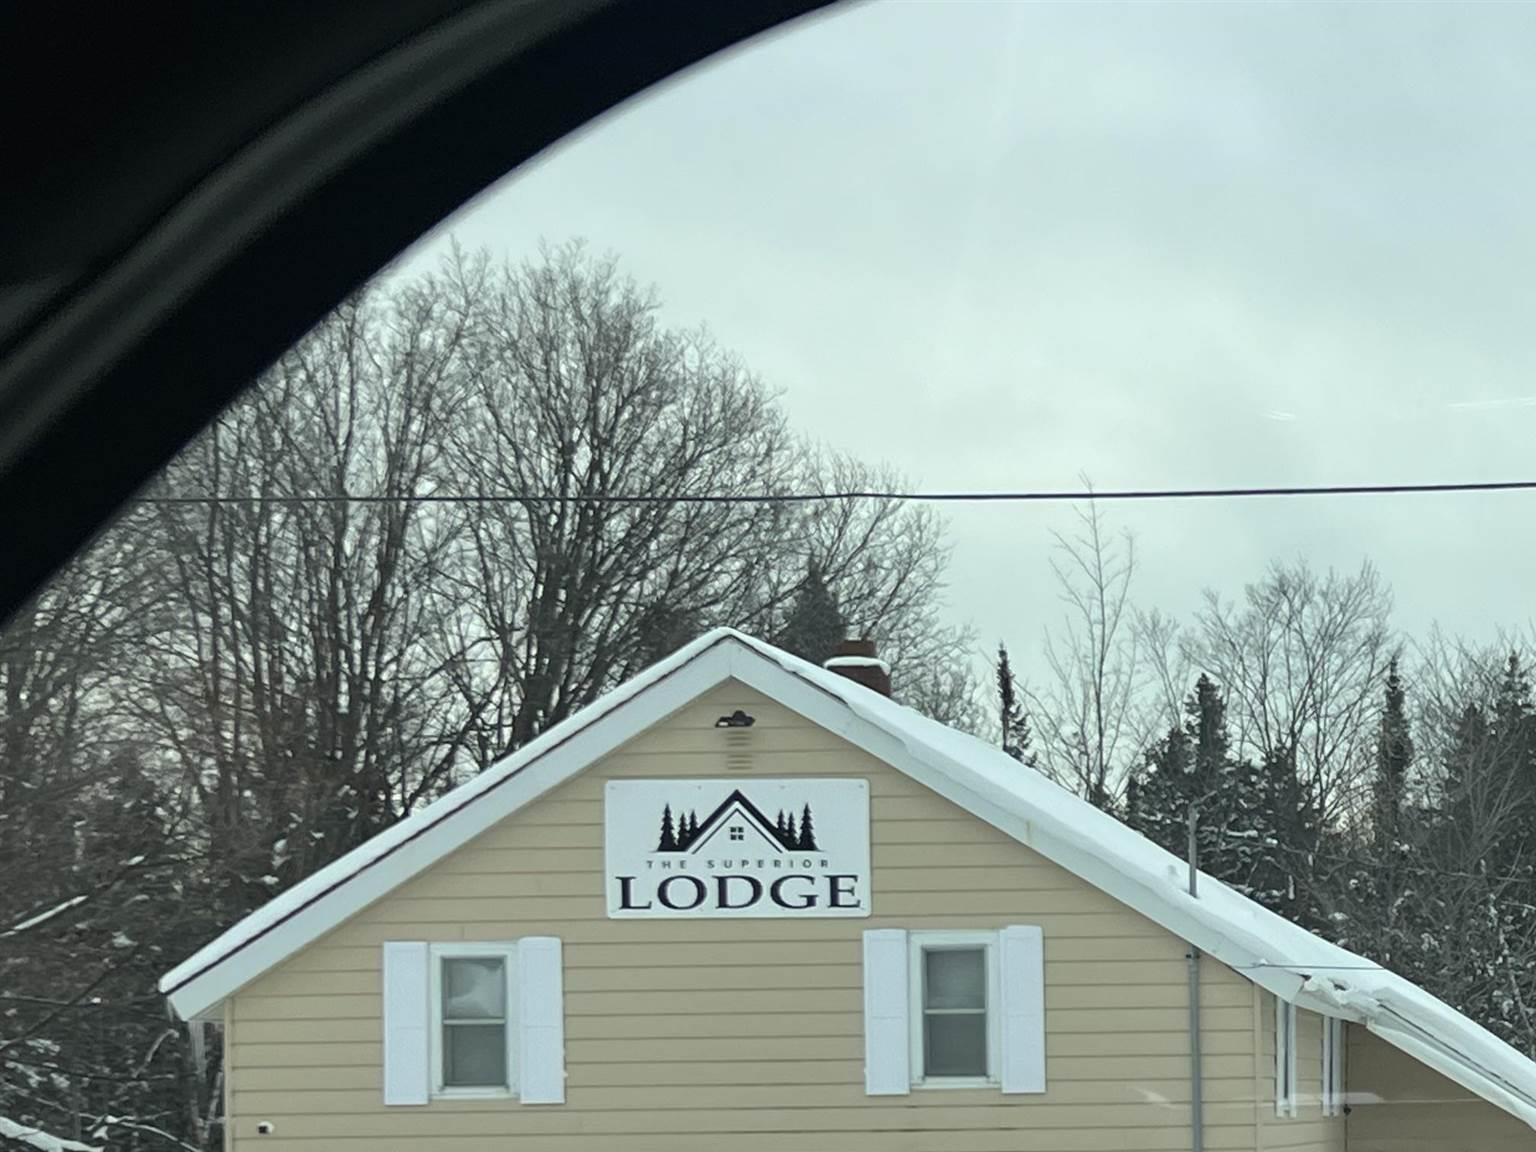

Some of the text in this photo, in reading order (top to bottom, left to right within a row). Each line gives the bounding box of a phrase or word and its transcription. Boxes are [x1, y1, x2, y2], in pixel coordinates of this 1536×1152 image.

[646, 859, 830, 870] THE SUPERIOR
[614, 874, 861, 911] LODGE
